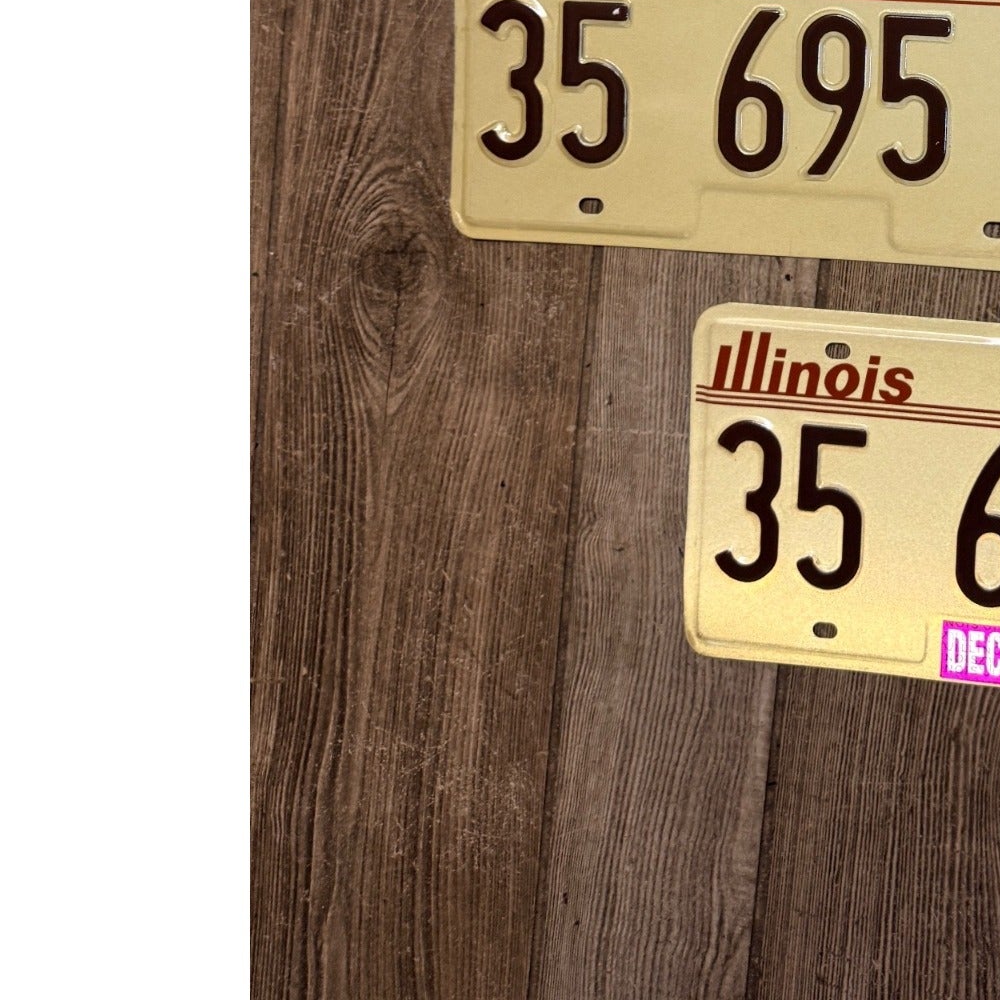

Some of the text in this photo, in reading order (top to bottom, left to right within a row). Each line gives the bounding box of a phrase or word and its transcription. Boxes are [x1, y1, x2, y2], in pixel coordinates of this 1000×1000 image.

[479, 0, 630, 164] 35
[716, 8, 953, 182] 695
[712, 331, 914, 404] Illinois
[714, 420, 868, 590] 35
